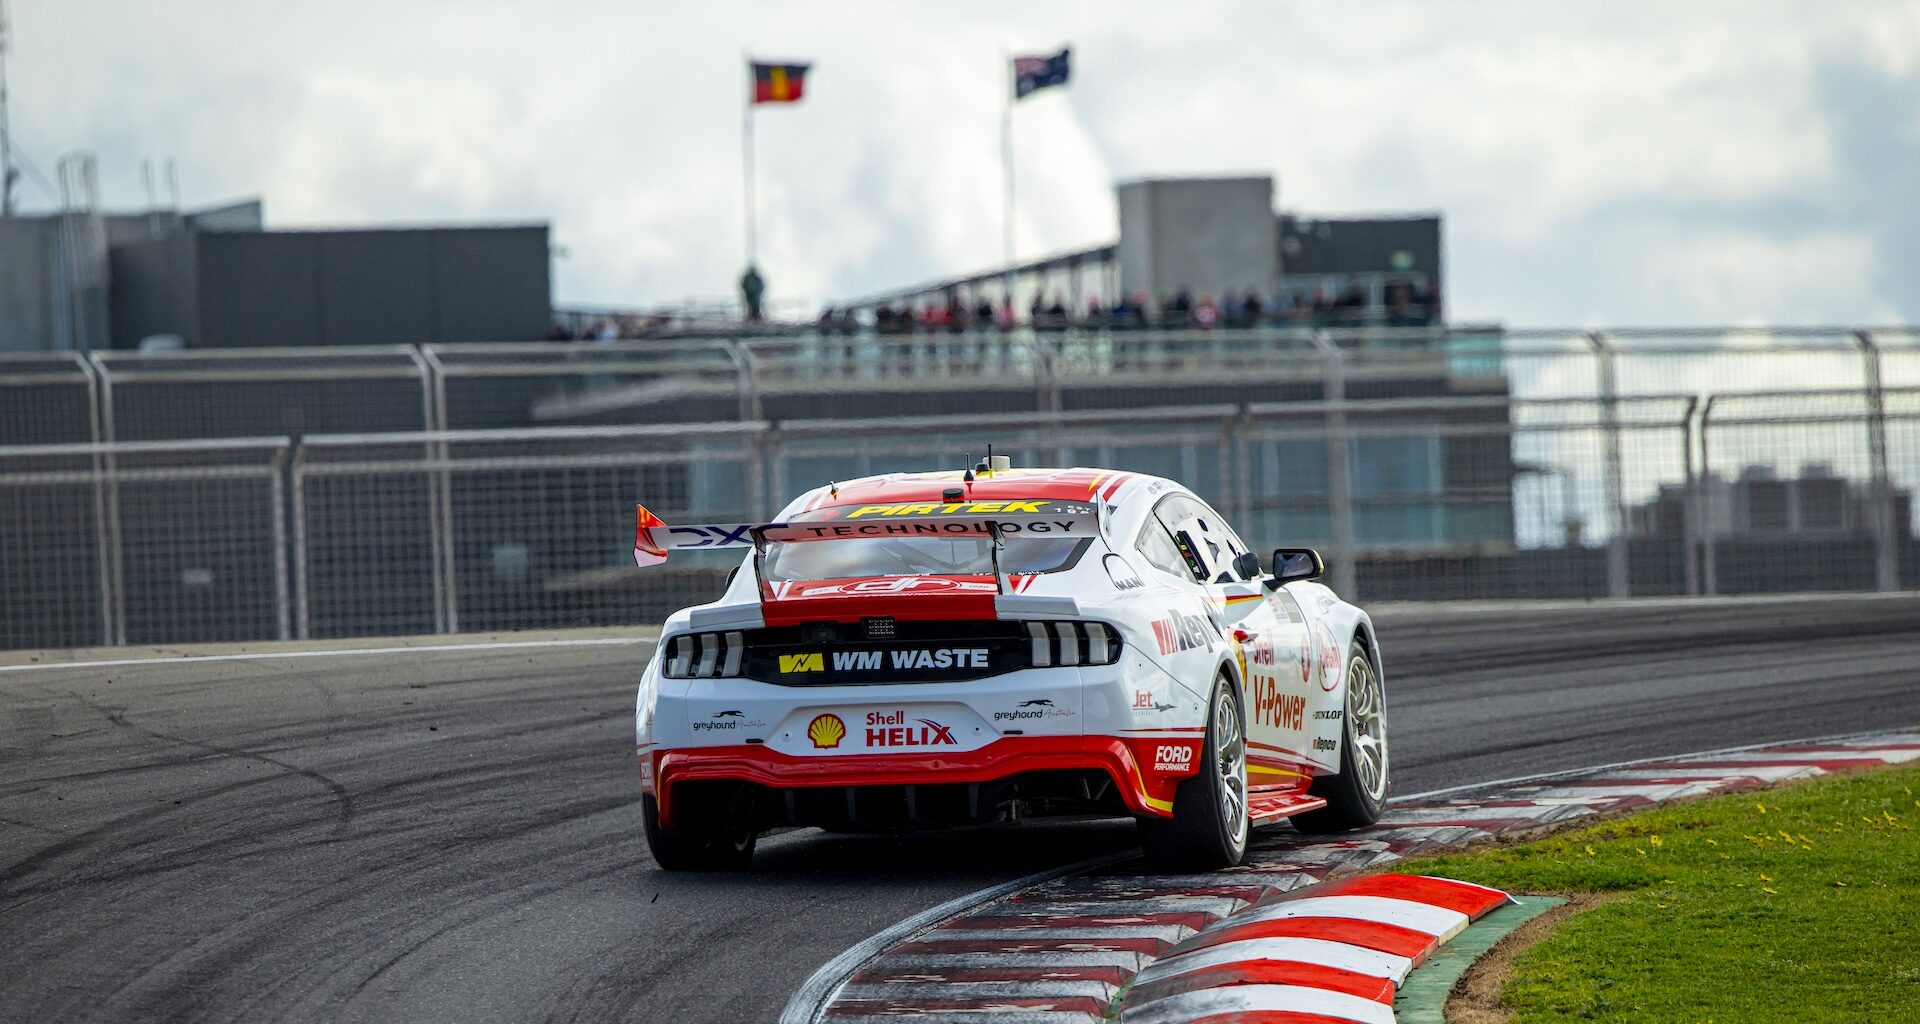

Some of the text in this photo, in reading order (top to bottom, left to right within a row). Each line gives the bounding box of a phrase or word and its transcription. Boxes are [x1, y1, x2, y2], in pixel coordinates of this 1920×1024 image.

[846, 501, 1052, 518] PIRTEK
[669, 519, 1075, 547] DXC TECHNOLOGY
[832, 648, 989, 671] WM WASTE
[1132, 690, 1153, 708] Jet
[1254, 675, 1307, 732] V-Power
[866, 710, 904, 725] Shell
[993, 709, 1043, 721] greyhound
[693, 720, 736, 732] greyhound
[865, 725, 957, 747] HELIX
[1155, 745, 1192, 763] FORD
[1153, 762, 1191, 772] PERFORMANCE
